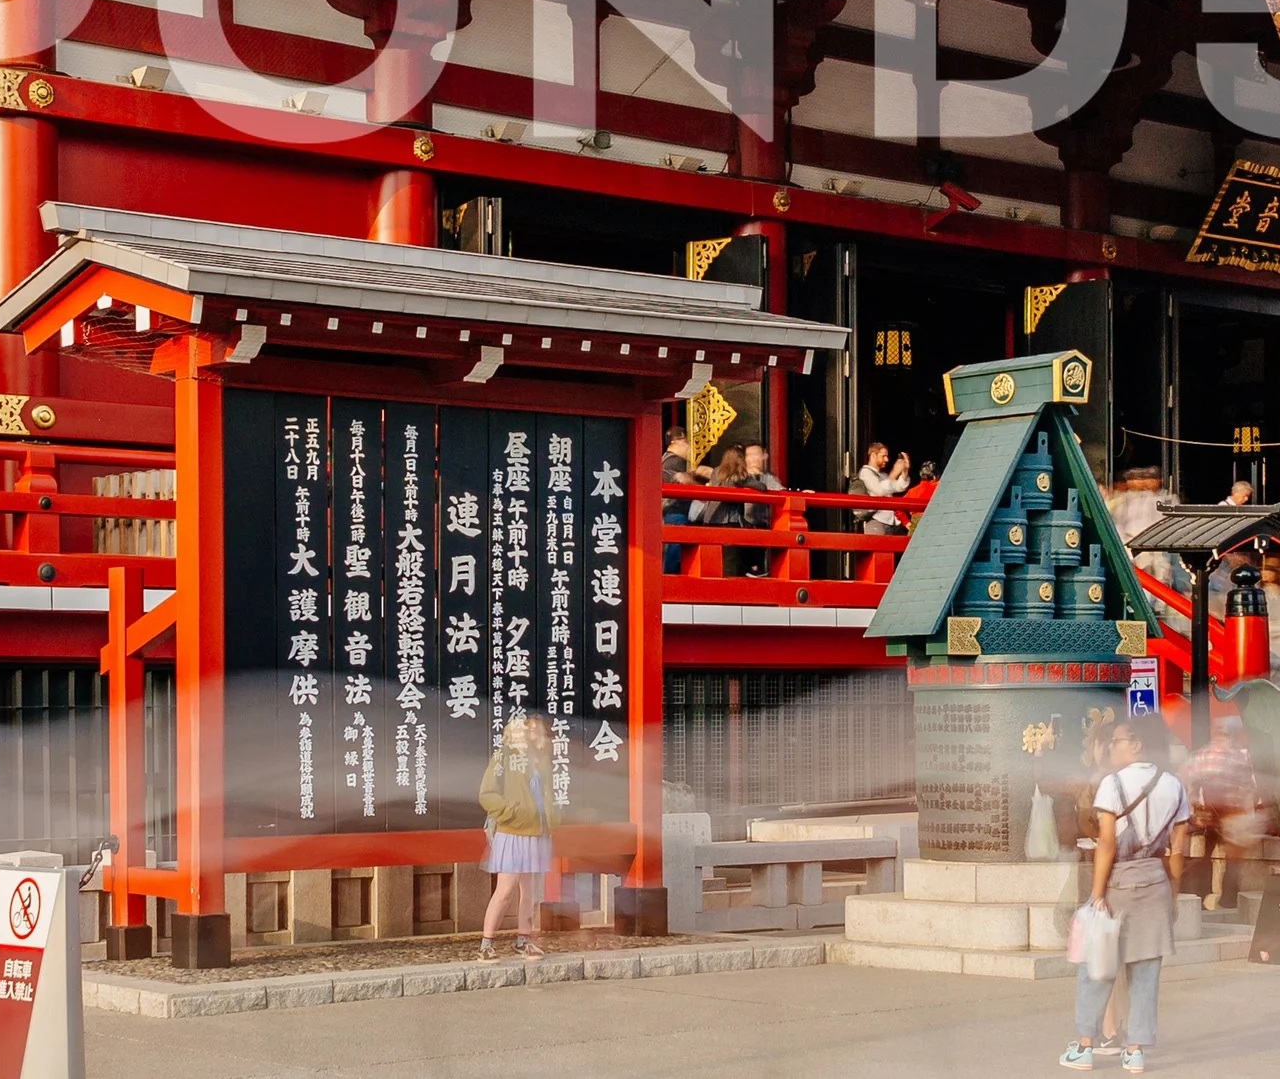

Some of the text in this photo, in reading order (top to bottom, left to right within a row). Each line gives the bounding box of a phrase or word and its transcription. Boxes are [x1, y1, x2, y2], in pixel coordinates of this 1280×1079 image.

[349, 419, 365, 544] 毎月十八日午後二時
[403, 424, 418, 521] 毎月一日午前十時
[504, 432, 531, 492] 昼座
[548, 433, 572, 492] 朝座
[295, 486, 310, 542] 午前十時
[507, 498, 529, 591] 午前十時
[287, 543, 320, 706] 大護摩供
[344, 544, 372, 705] 聖観音法
[395, 523, 426, 710] 大般若経転読会
[445, 492, 481, 719] 連月法要
[505, 616, 530, 677] 夕座
[551, 568, 570, 644] 午前六時
[588, 461, 624, 762] 本堂連日法会
[551, 718, 570, 809] 午前六時半
[4, 959, 32, 979] 自転車
